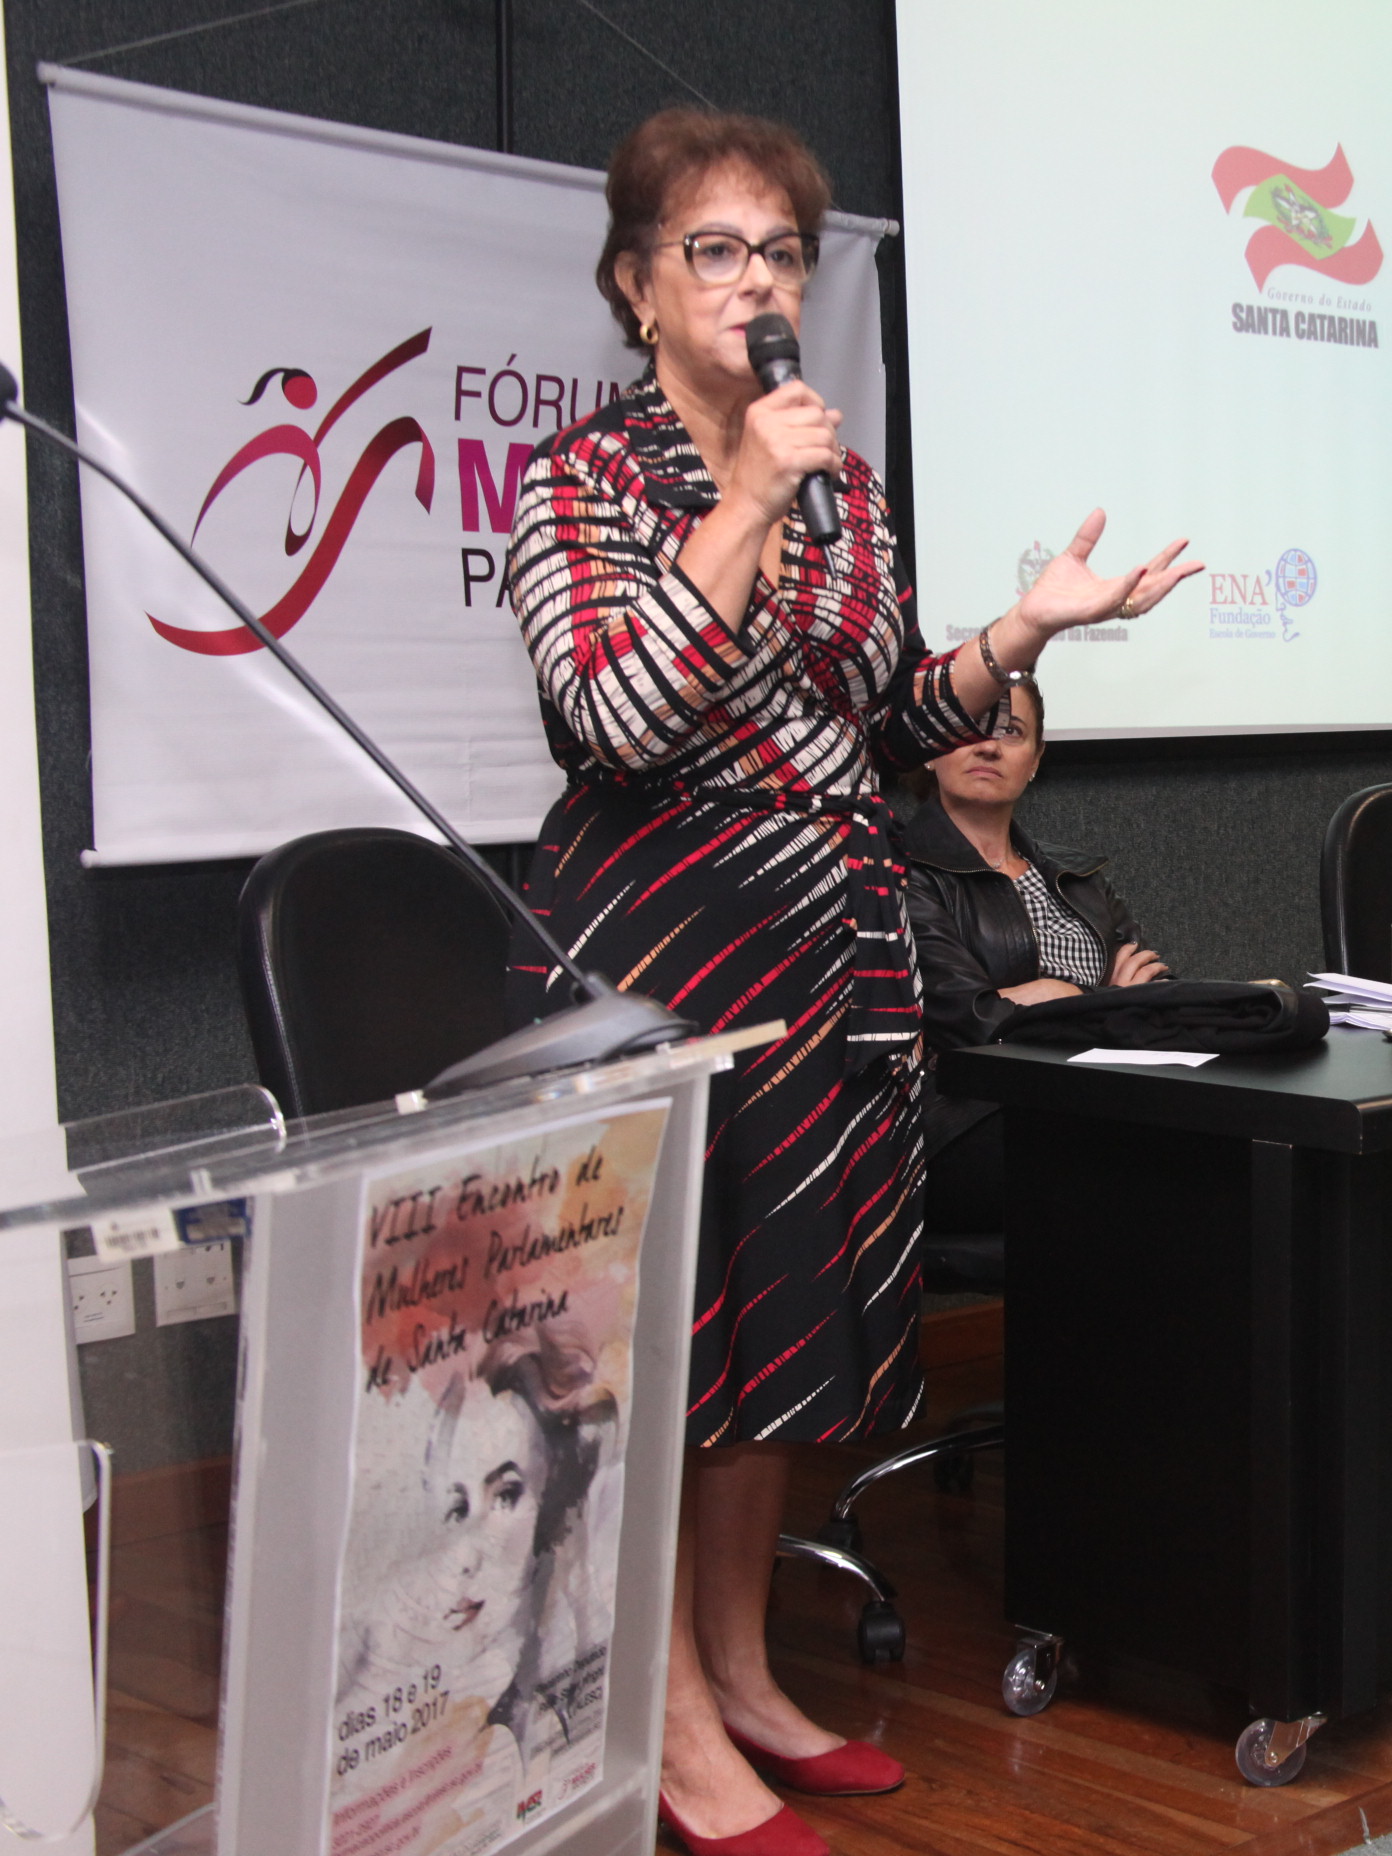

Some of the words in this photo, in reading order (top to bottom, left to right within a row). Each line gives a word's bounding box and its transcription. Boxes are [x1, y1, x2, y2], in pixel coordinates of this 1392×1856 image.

[1231, 302, 1291, 338] SANTA
[1294, 310, 1379, 349] CATARINA
[1318, 293, 1332, 306] do
[1337, 296, 1372, 312] Estado
[1083, 624, 1129, 642] Fazenda
[1210, 607, 1271, 628] Fundação
[370, 1184, 442, 1249] VIII
[456, 1154, 560, 1221] Encontro
[575, 1144, 604, 1186] de
[365, 1255, 469, 1326] Mulheres
[483, 1202, 624, 1281] Parlamentares
[365, 1345, 392, 1394] de
[408, 1308, 467, 1373] Santa
[483, 1288, 568, 1344] Catarina
[336, 1746, 360, 1777] de
[364, 1721, 408, 1762] maio
[410, 1690, 450, 1735] 2017
[338, 1706, 377, 1742] dias
[383, 1686, 403, 1718] 18
[407, 1683, 417, 1704] e
[422, 1663, 442, 1694] 19
